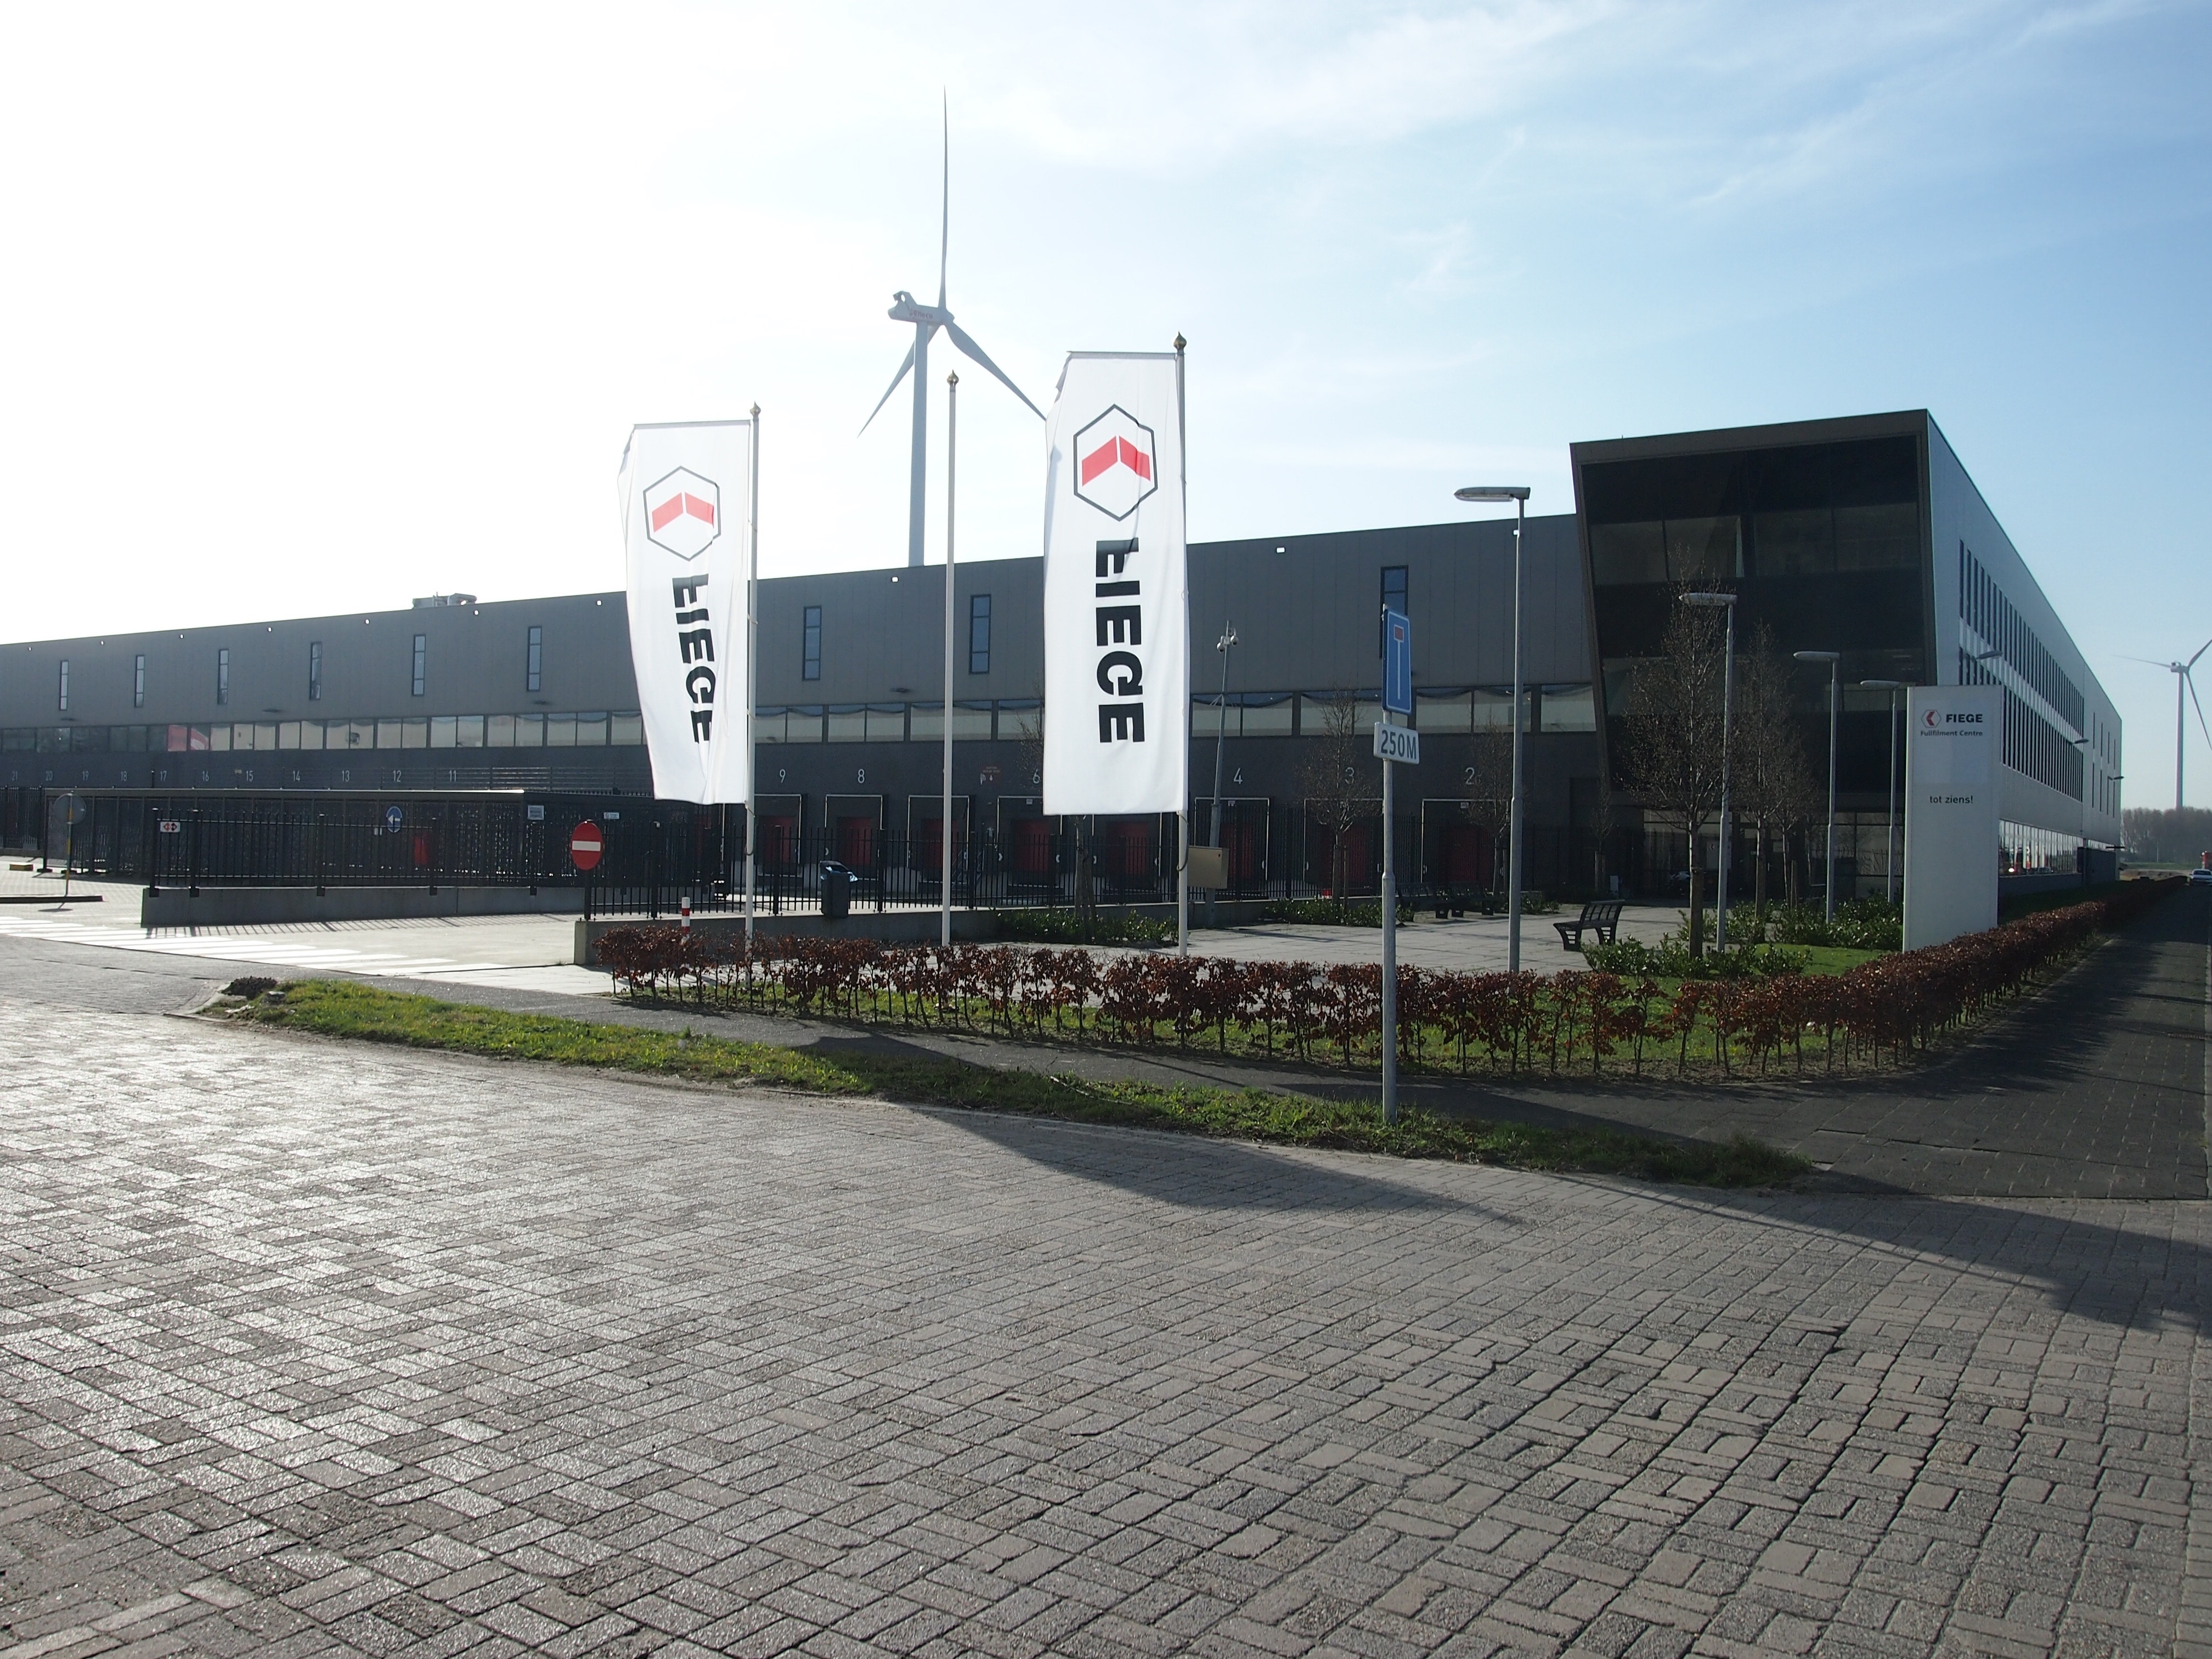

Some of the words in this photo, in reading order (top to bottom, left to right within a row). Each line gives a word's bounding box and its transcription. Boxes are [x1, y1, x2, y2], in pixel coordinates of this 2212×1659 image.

[1946, 714, 1983, 723] FIEGE
[1381, 730, 1417, 760] 250M
[12, 771, 18, 781] 21
[46, 771, 53, 781] 20
[83, 771, 89, 781] 19
[121, 771, 127, 781] 18
[160, 770, 167, 781] 17
[202, 770, 210, 782] 16
[246, 770, 253, 782] 15
[292, 770, 301, 782] 14
[342, 770, 350, 782] 13
[393, 770, 402, 782] 12
[449, 770, 457, 782] 11
[780, 769, 786, 783] 9
[857, 769, 865, 783] 8
[1032, 769, 1040, 784] 6
[1233, 768, 1243, 784] 4
[1345, 767, 1355, 784] 3
[1465, 767, 1475, 785] 2
[1945, 795, 1973, 804] ziens!
